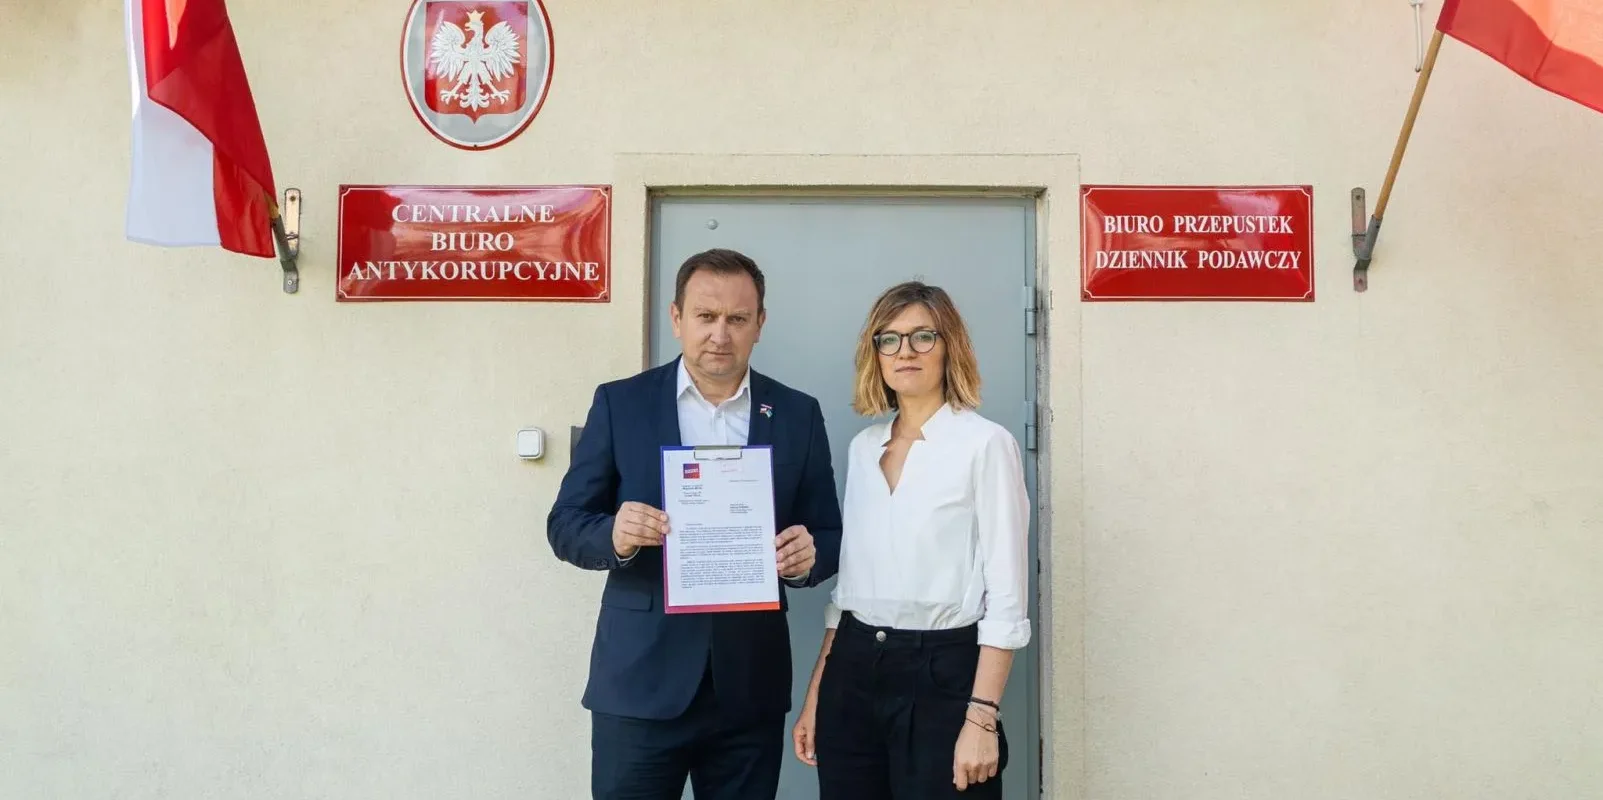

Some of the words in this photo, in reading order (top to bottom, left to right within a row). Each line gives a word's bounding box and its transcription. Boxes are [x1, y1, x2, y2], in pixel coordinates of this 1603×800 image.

[391, 204, 555, 223] CENTRALNE
[1103, 215, 1164, 234] BIURO
[1173, 215, 1293, 234] PRZEPUSTEK
[430, 232, 514, 251] BIURO
[1095, 250, 1188, 269] DZIENNIK
[1197, 250, 1302, 269] PODAWCZY
[347, 261, 600, 281] ANTYKORUPCYJNE
